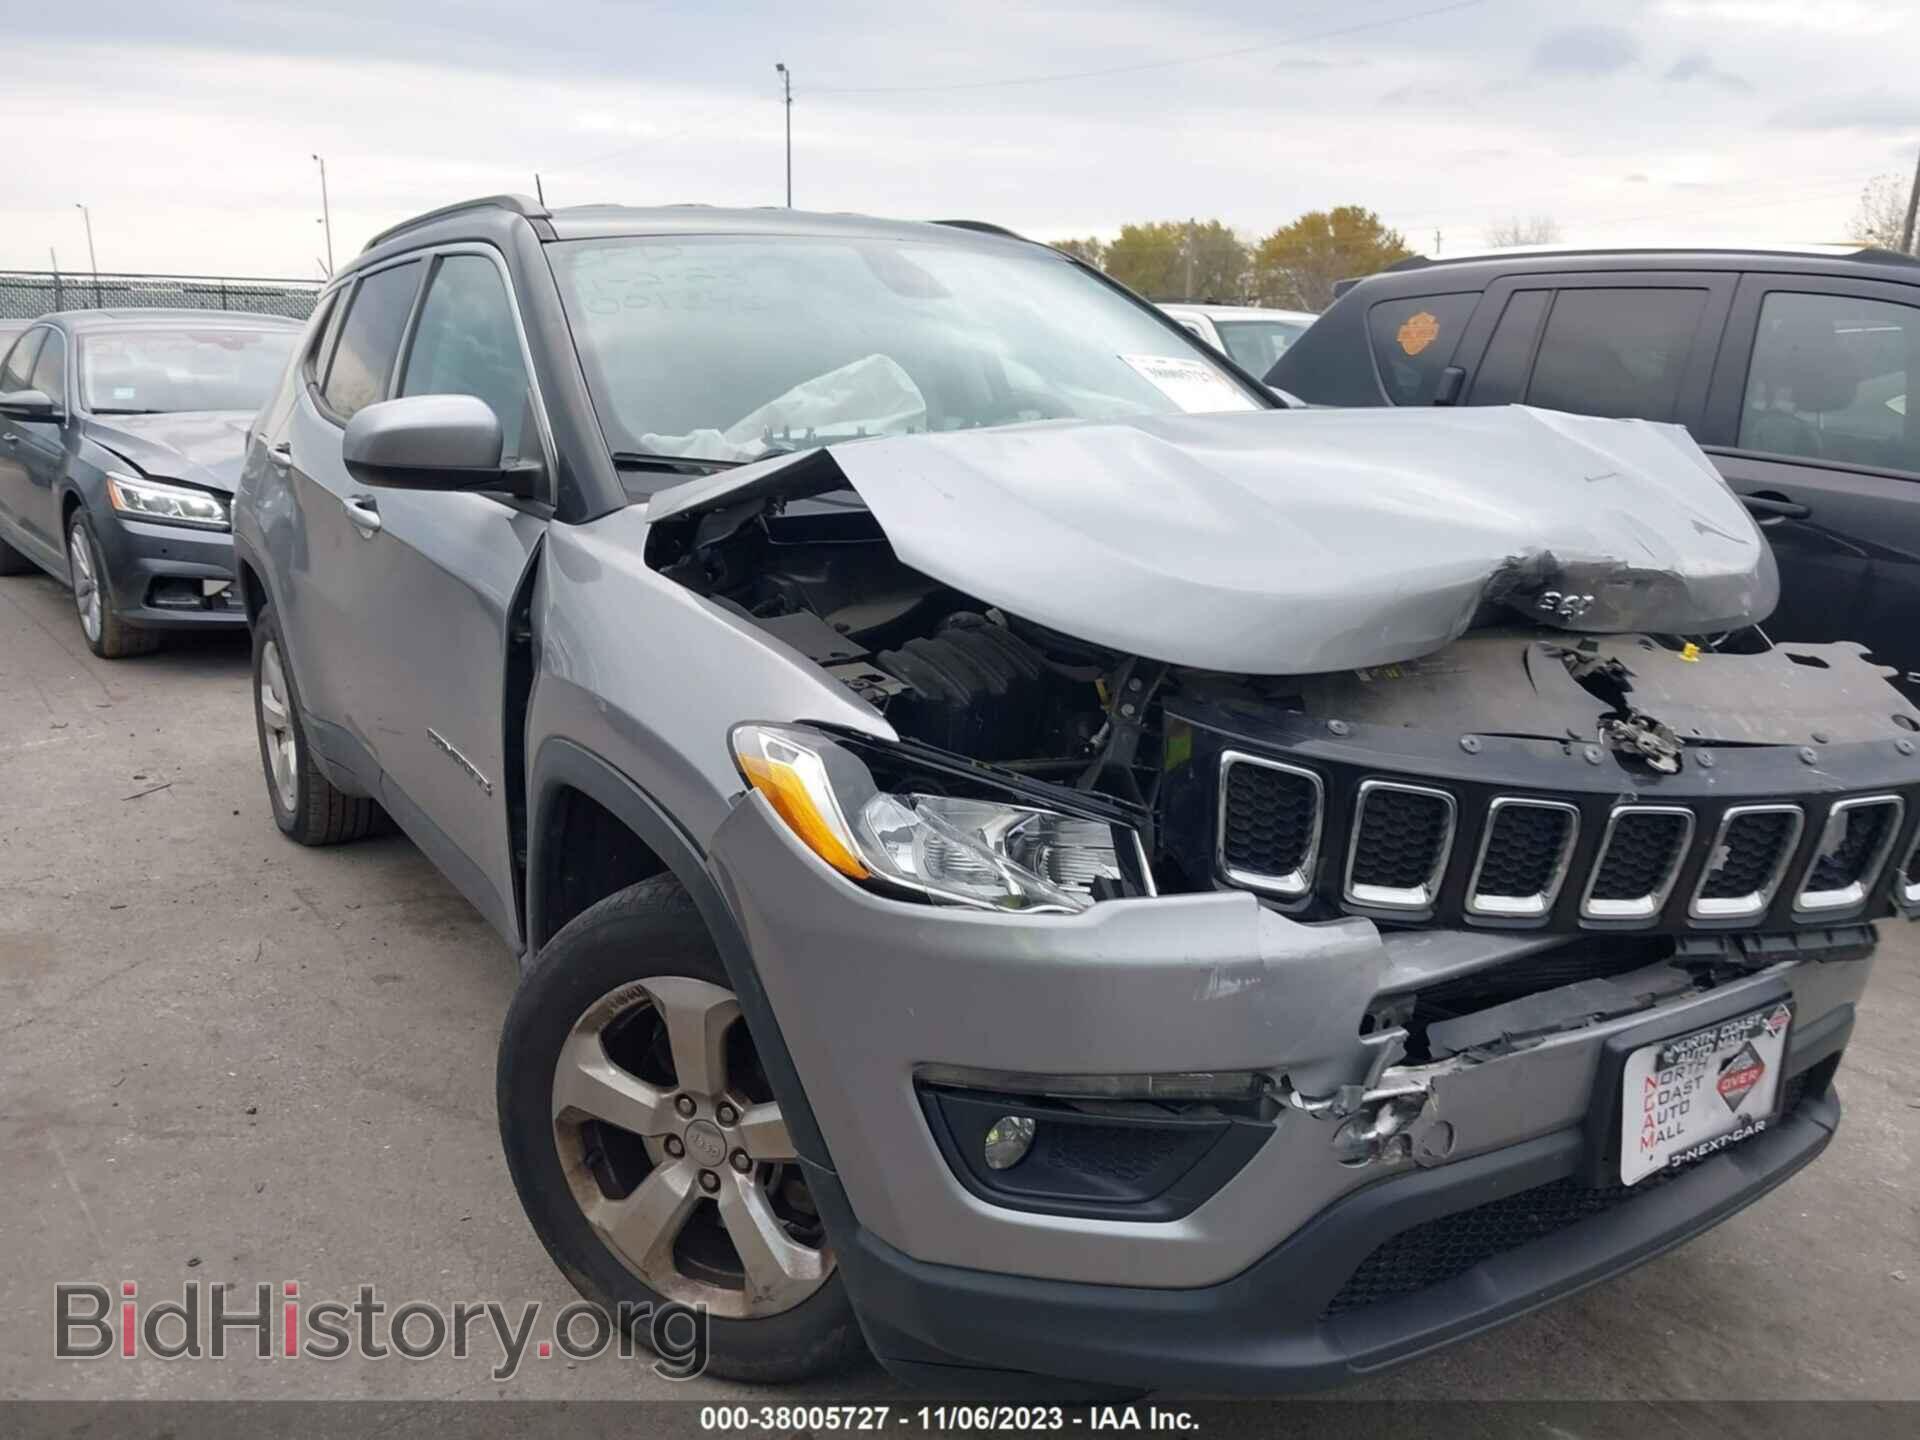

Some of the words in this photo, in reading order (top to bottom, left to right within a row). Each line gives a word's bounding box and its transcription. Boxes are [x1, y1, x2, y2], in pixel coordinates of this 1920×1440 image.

[1644, 1057, 1708, 1092] NORTH
[1644, 1075, 1705, 1112] COAST
[1642, 1099, 1691, 1134] AUTO
[1640, 1122, 1686, 1152] MALL
